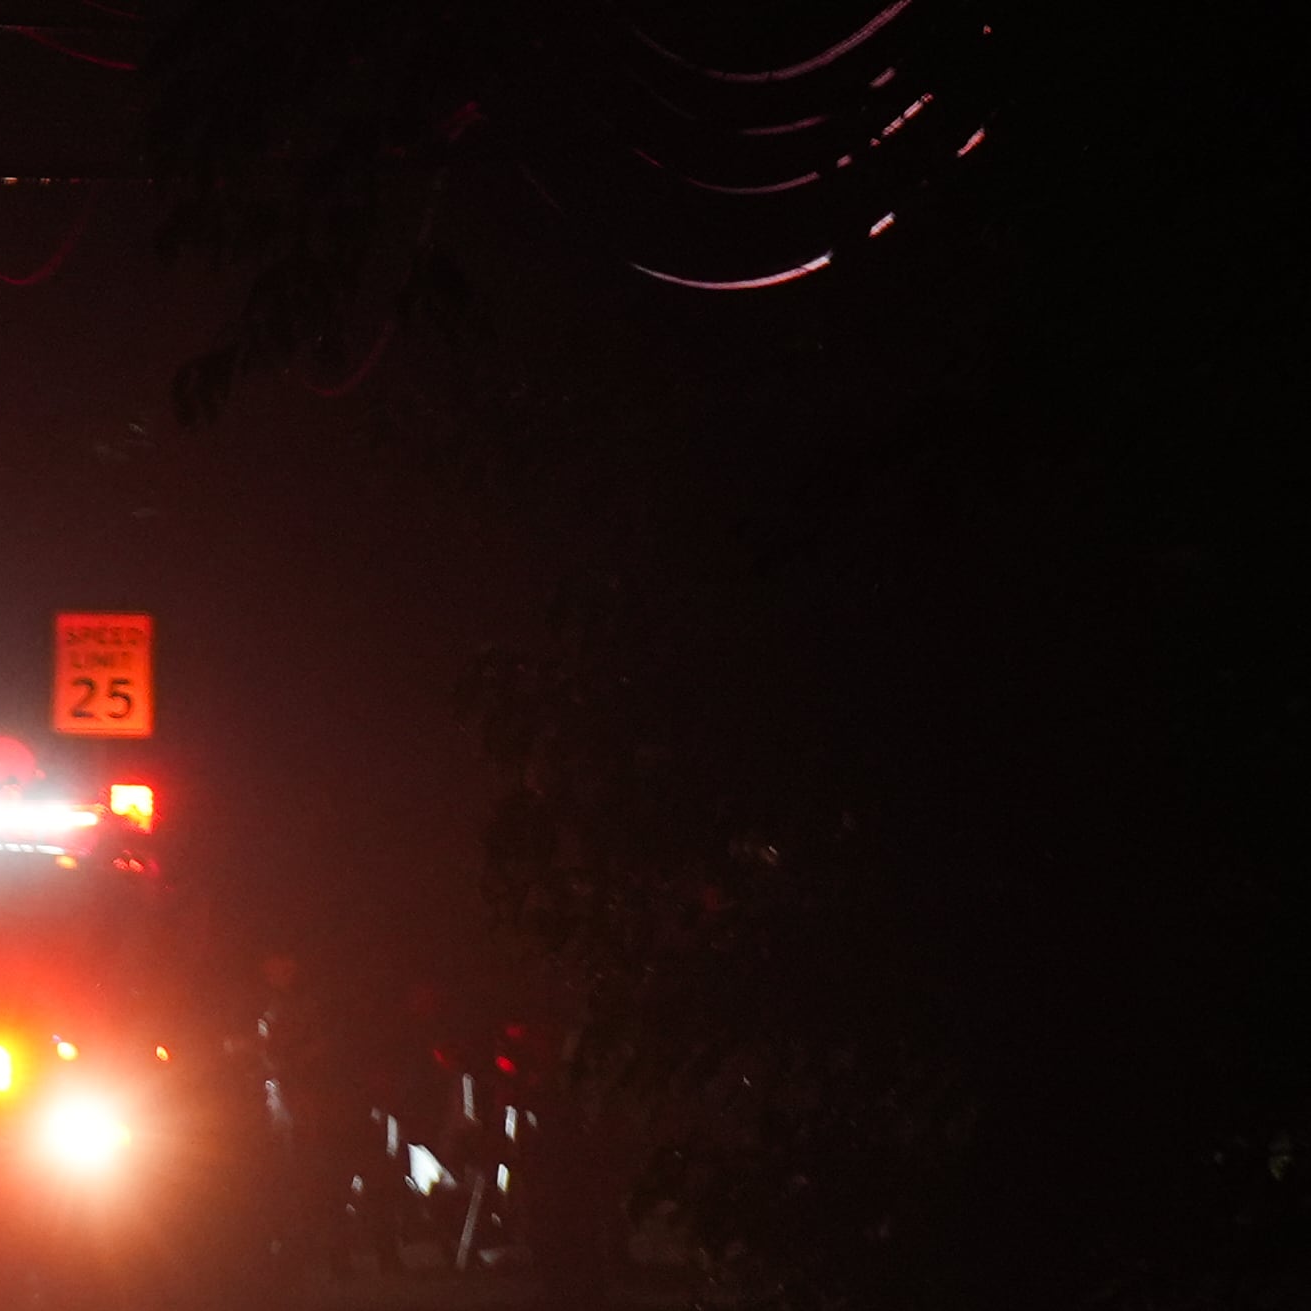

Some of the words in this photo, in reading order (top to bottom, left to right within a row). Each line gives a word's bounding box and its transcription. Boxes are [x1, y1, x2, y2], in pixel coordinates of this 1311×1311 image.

[65, 626, 144, 646] SPEED
[68, 650, 132, 669] LIMIT
[71, 676, 133, 719] 25
